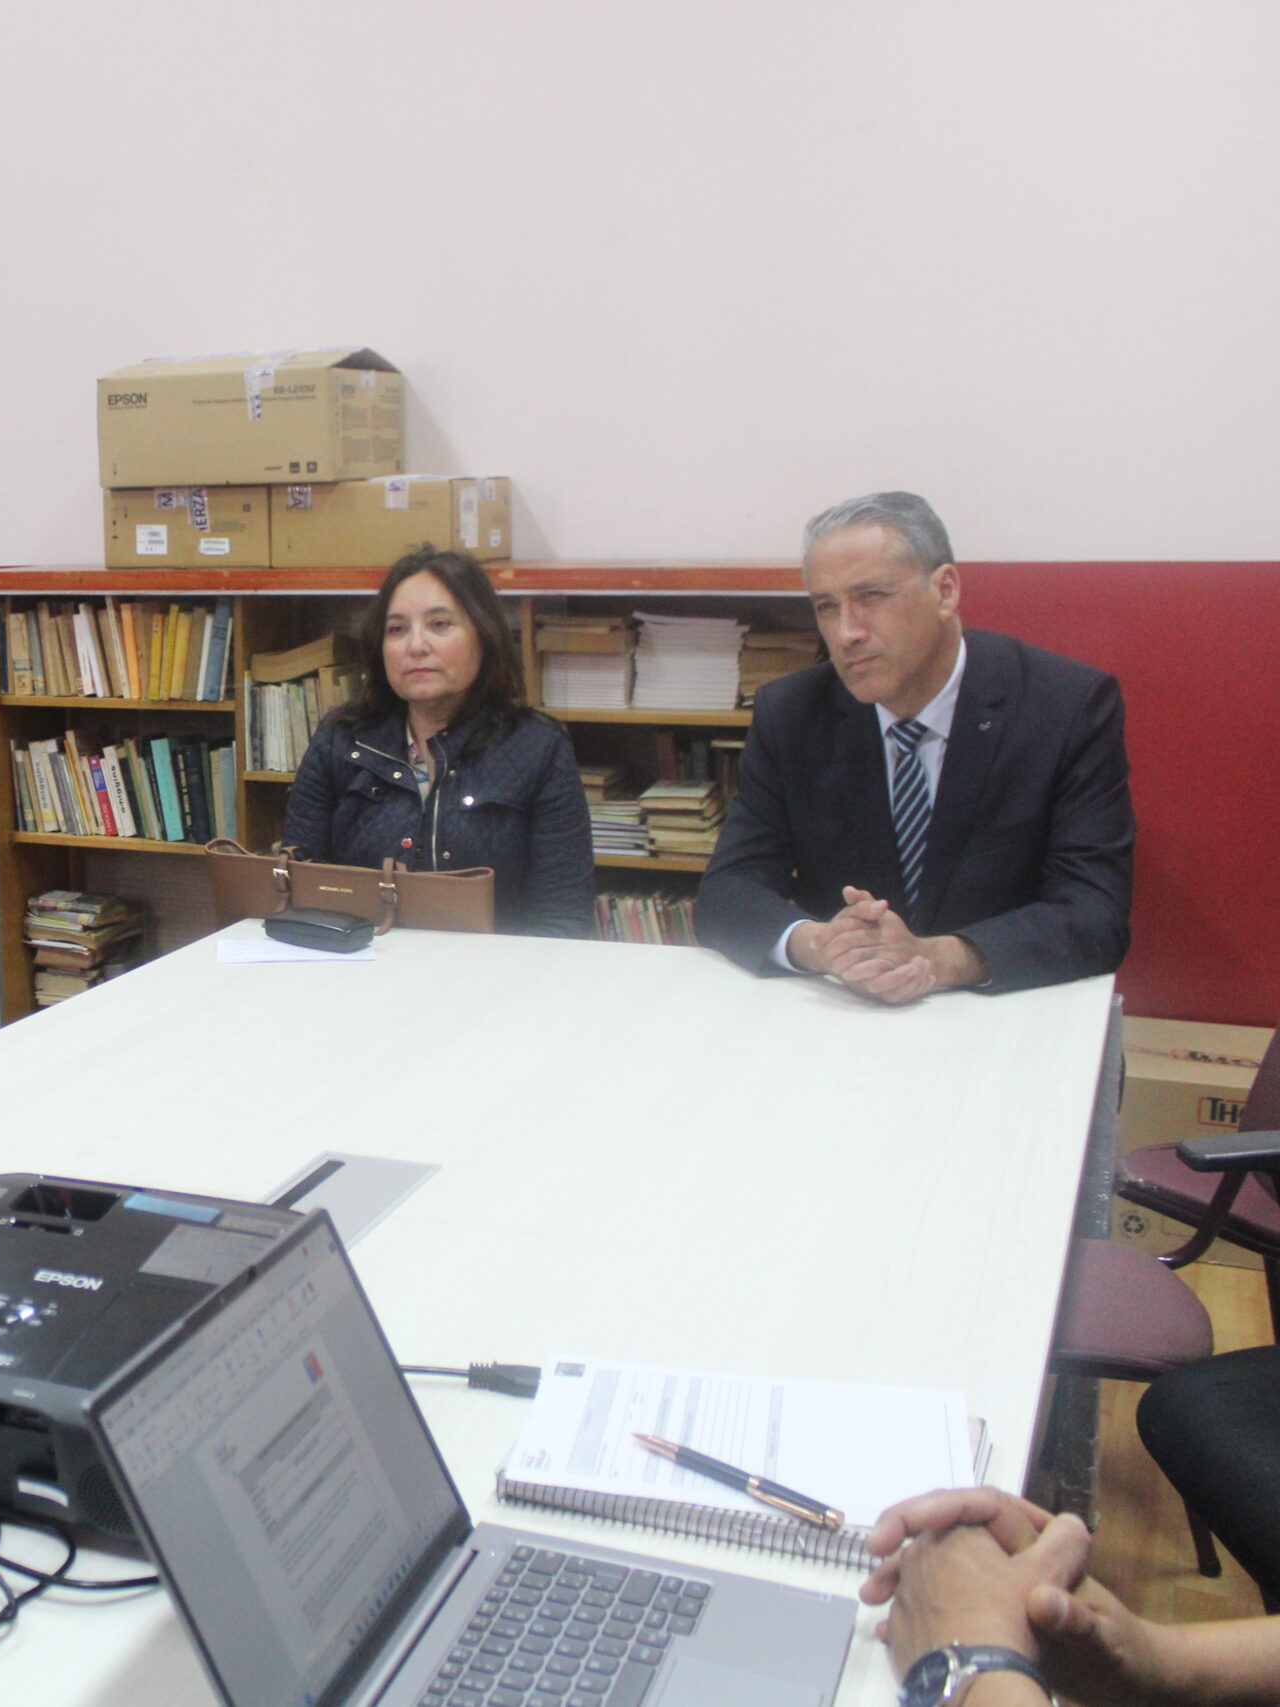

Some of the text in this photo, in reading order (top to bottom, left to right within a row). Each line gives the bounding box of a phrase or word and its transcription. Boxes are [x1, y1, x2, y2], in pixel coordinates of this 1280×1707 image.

[107, 392, 148, 406] EPSON
[1207, 1097, 1245, 1123] TH
[34, 1268, 103, 1291] EPSON
